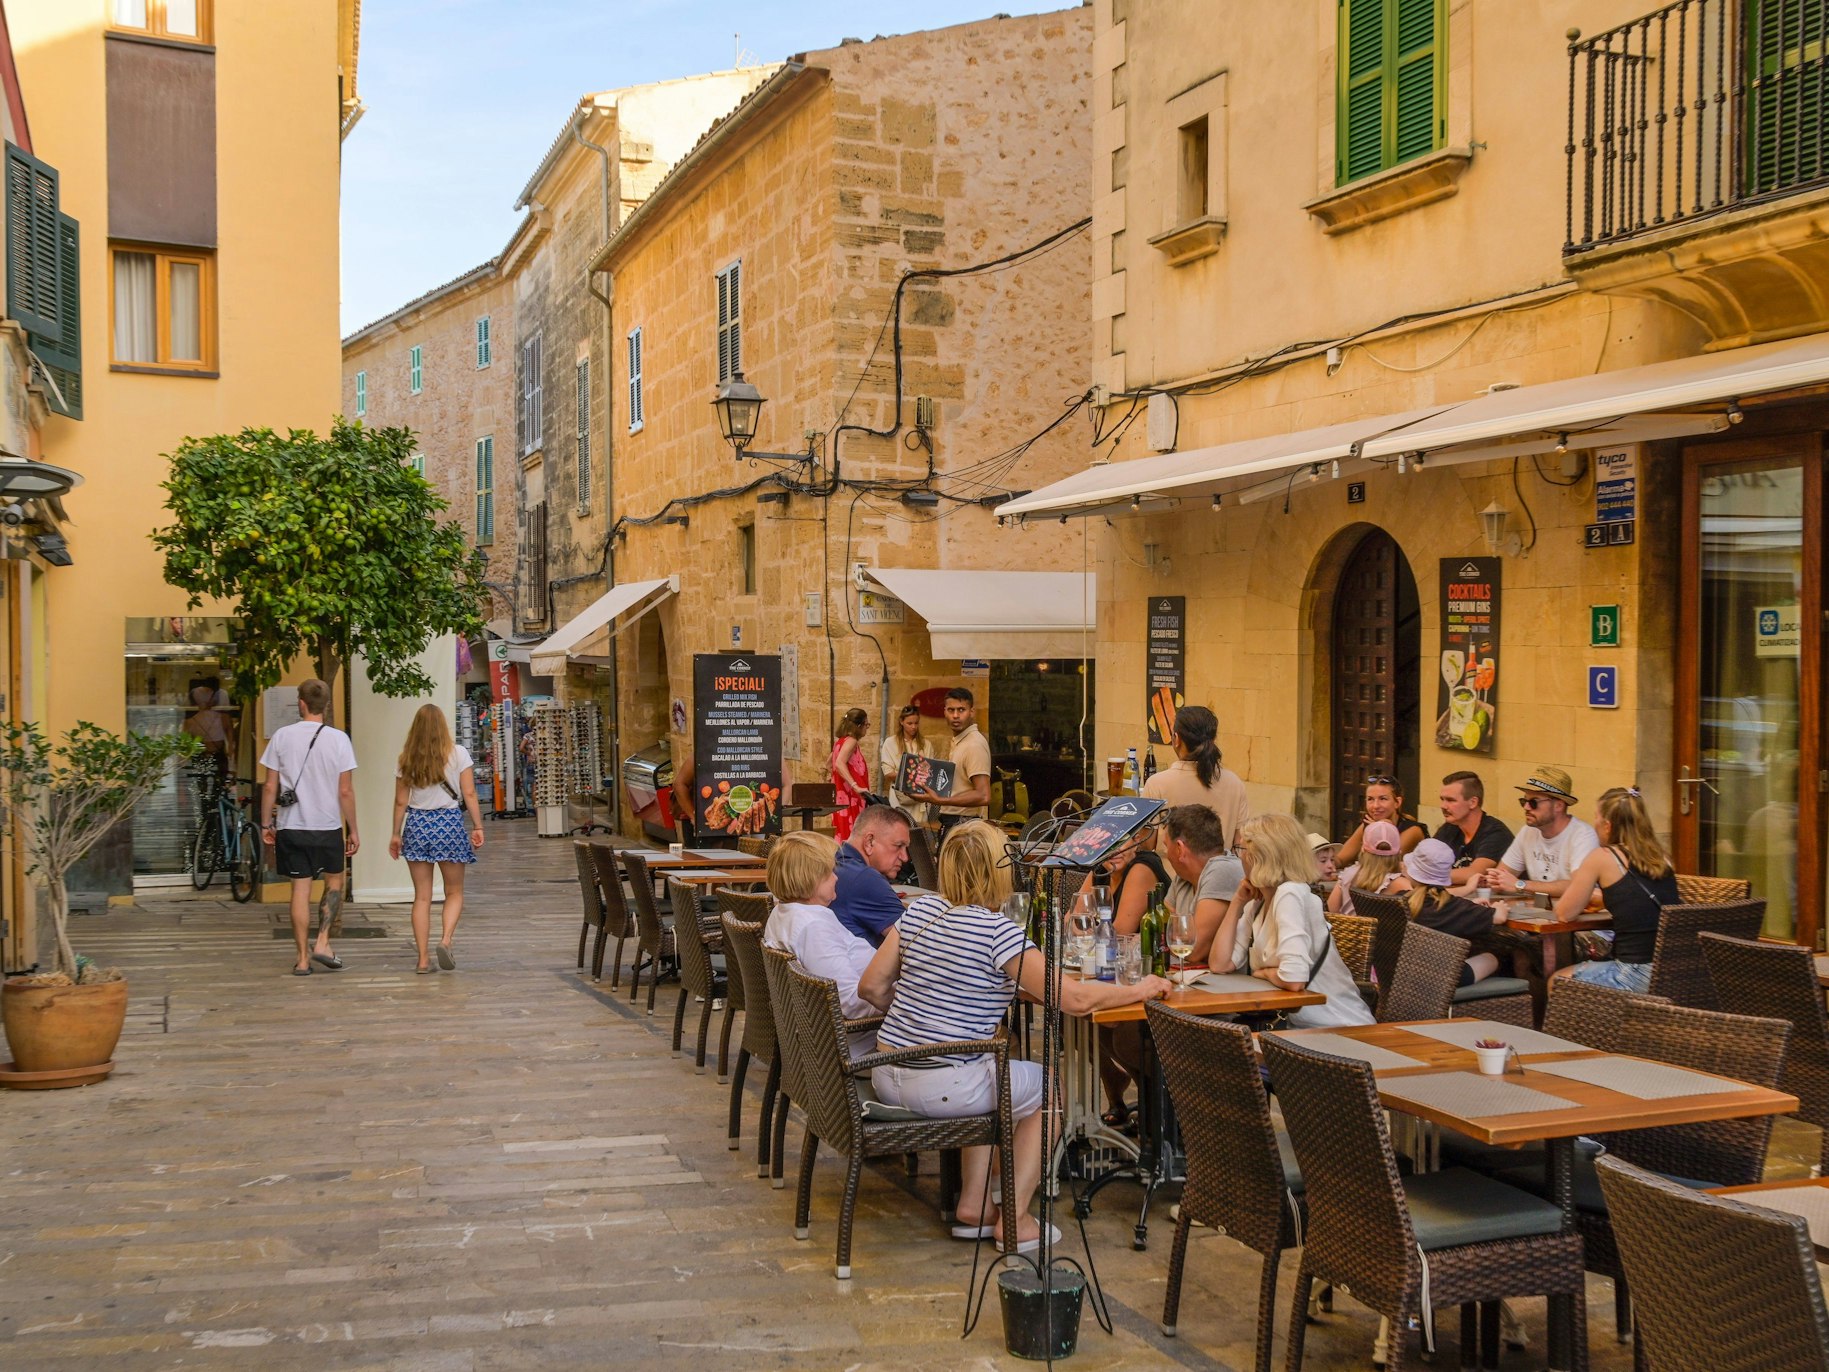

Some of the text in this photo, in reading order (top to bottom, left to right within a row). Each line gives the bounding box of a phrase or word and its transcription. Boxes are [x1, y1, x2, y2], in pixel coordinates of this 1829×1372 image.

[1597, 453, 1627, 468] tyco
[1352, 486, 1359, 499] 2
[1591, 524, 1625, 544] 2 A
[1448, 584, 1491, 600] COCKTAILS
[1448, 601, 1490, 612] PREMIUM GINS
[861, 608, 878, 620] SANT
[1151, 616, 1179, 628] FRESH FISH
[1598, 614, 1612, 636] B
[715, 676, 765, 690] ¡SPECIAL!
[1596, 672, 1608, 694] C
